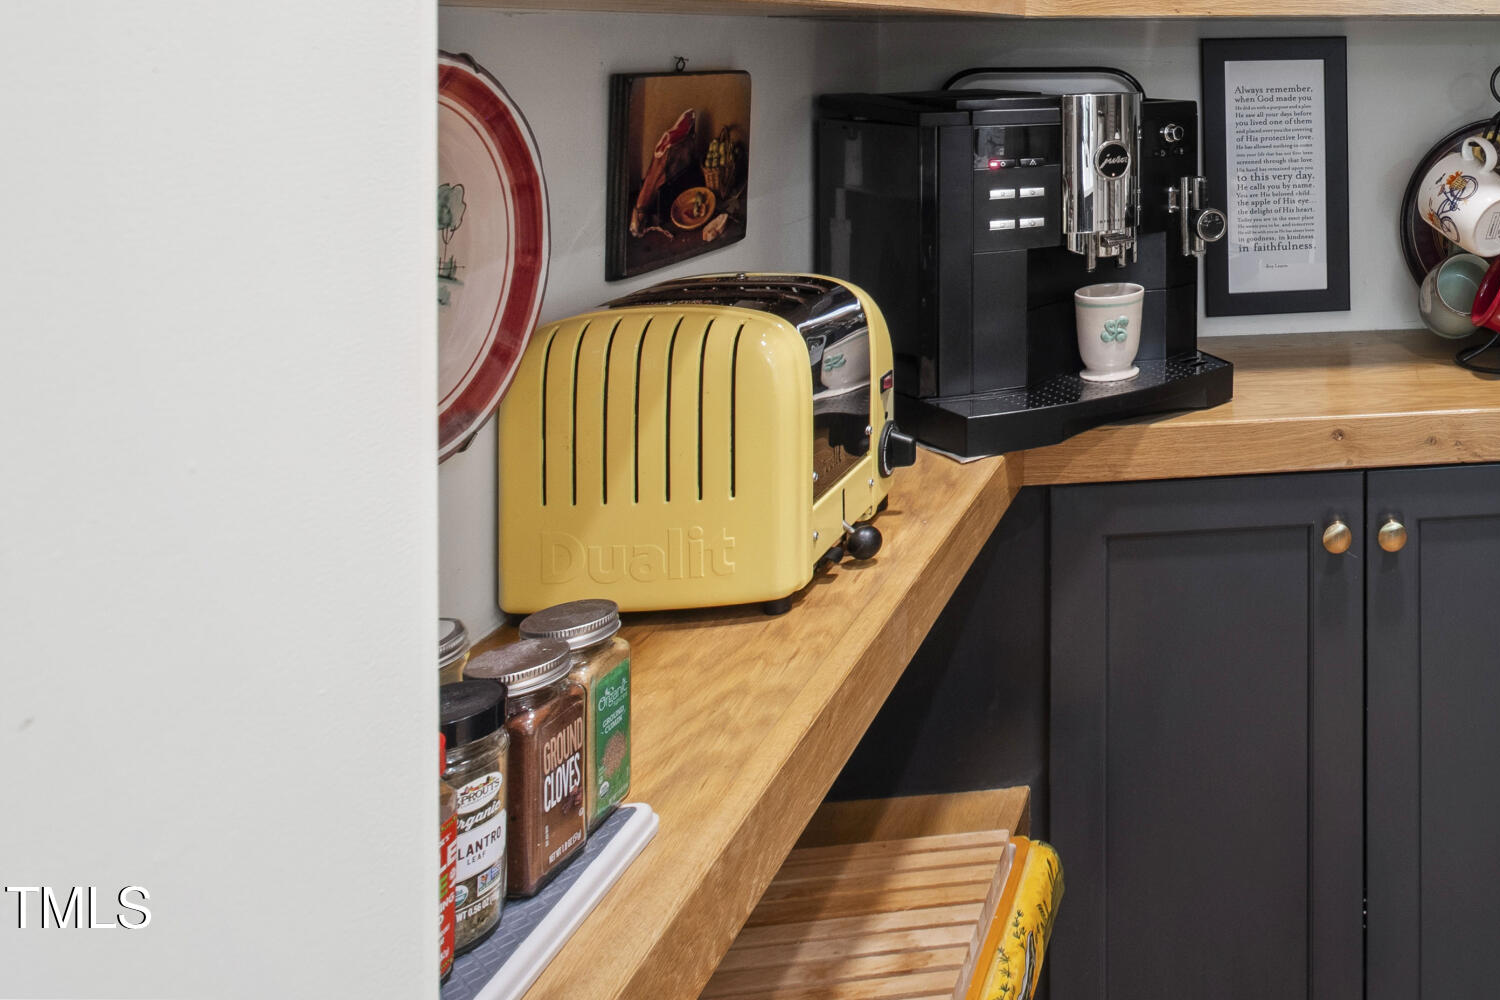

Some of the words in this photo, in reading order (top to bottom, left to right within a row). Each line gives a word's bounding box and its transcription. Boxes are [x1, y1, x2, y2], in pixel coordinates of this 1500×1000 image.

[1235, 86, 1263, 95] Always
[1261, 135, 1295, 143] protective
[1251, 172, 1269, 181] this
[1272, 174, 1292, 183] very
[1296, 171, 1315, 182] day.
[1251, 198, 1272, 207] apple
[538, 527, 736, 586] Dualit
[603, 705, 625, 728] GROUND
[543, 717, 583, 775] GROUND
[543, 752, 581, 812] CLOVES
[457, 825, 502, 861] LANTRO
[467, 851, 487, 865] LEAF
